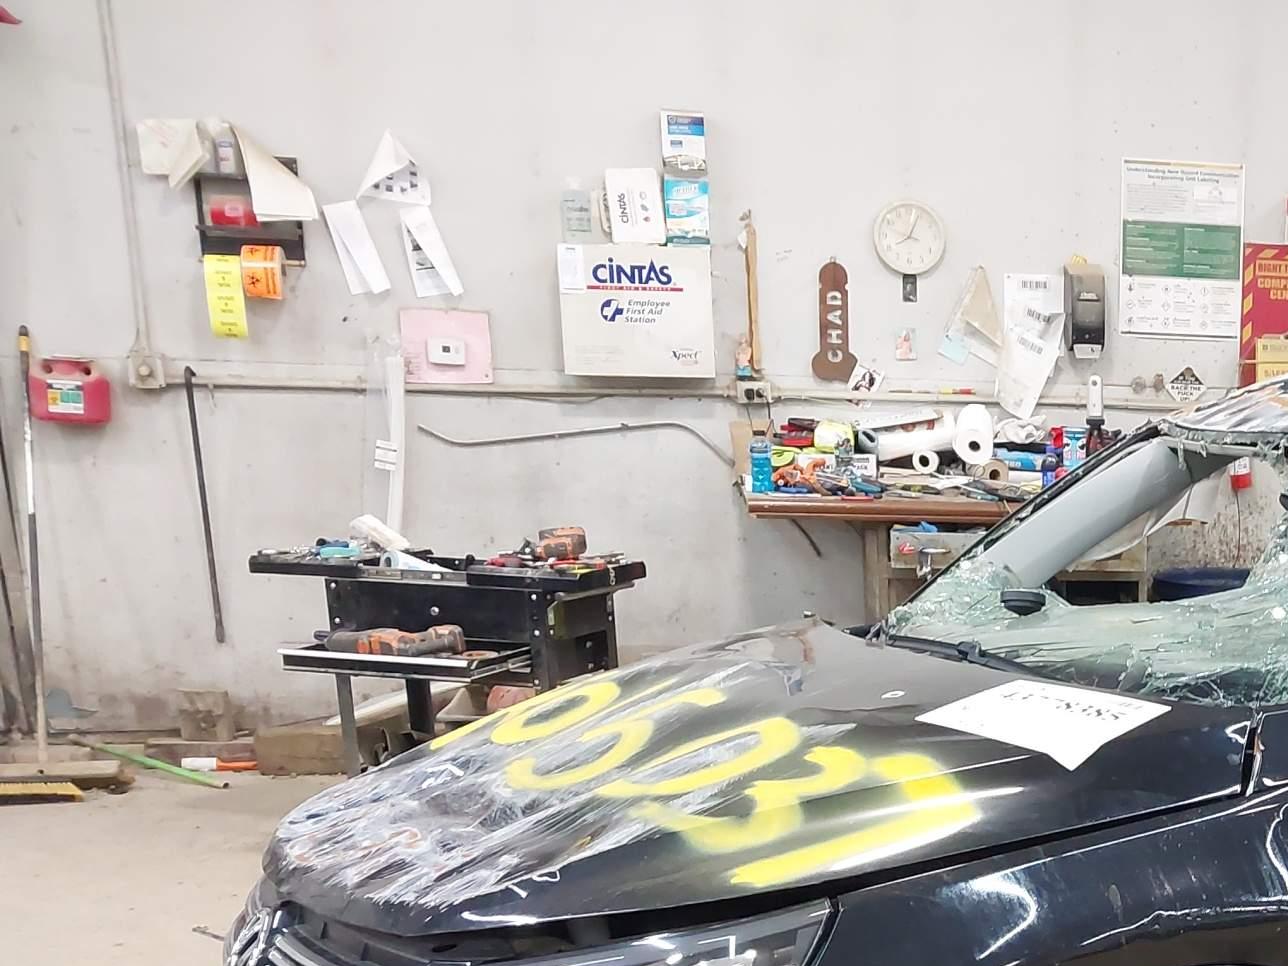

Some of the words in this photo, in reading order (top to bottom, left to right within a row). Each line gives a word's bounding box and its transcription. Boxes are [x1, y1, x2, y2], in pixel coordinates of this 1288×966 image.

[592, 257, 673, 285] CINTAS
[627, 300, 671, 309] Employee
[624, 316, 656, 324] Station
[826, 290, 843, 363] CHAD
